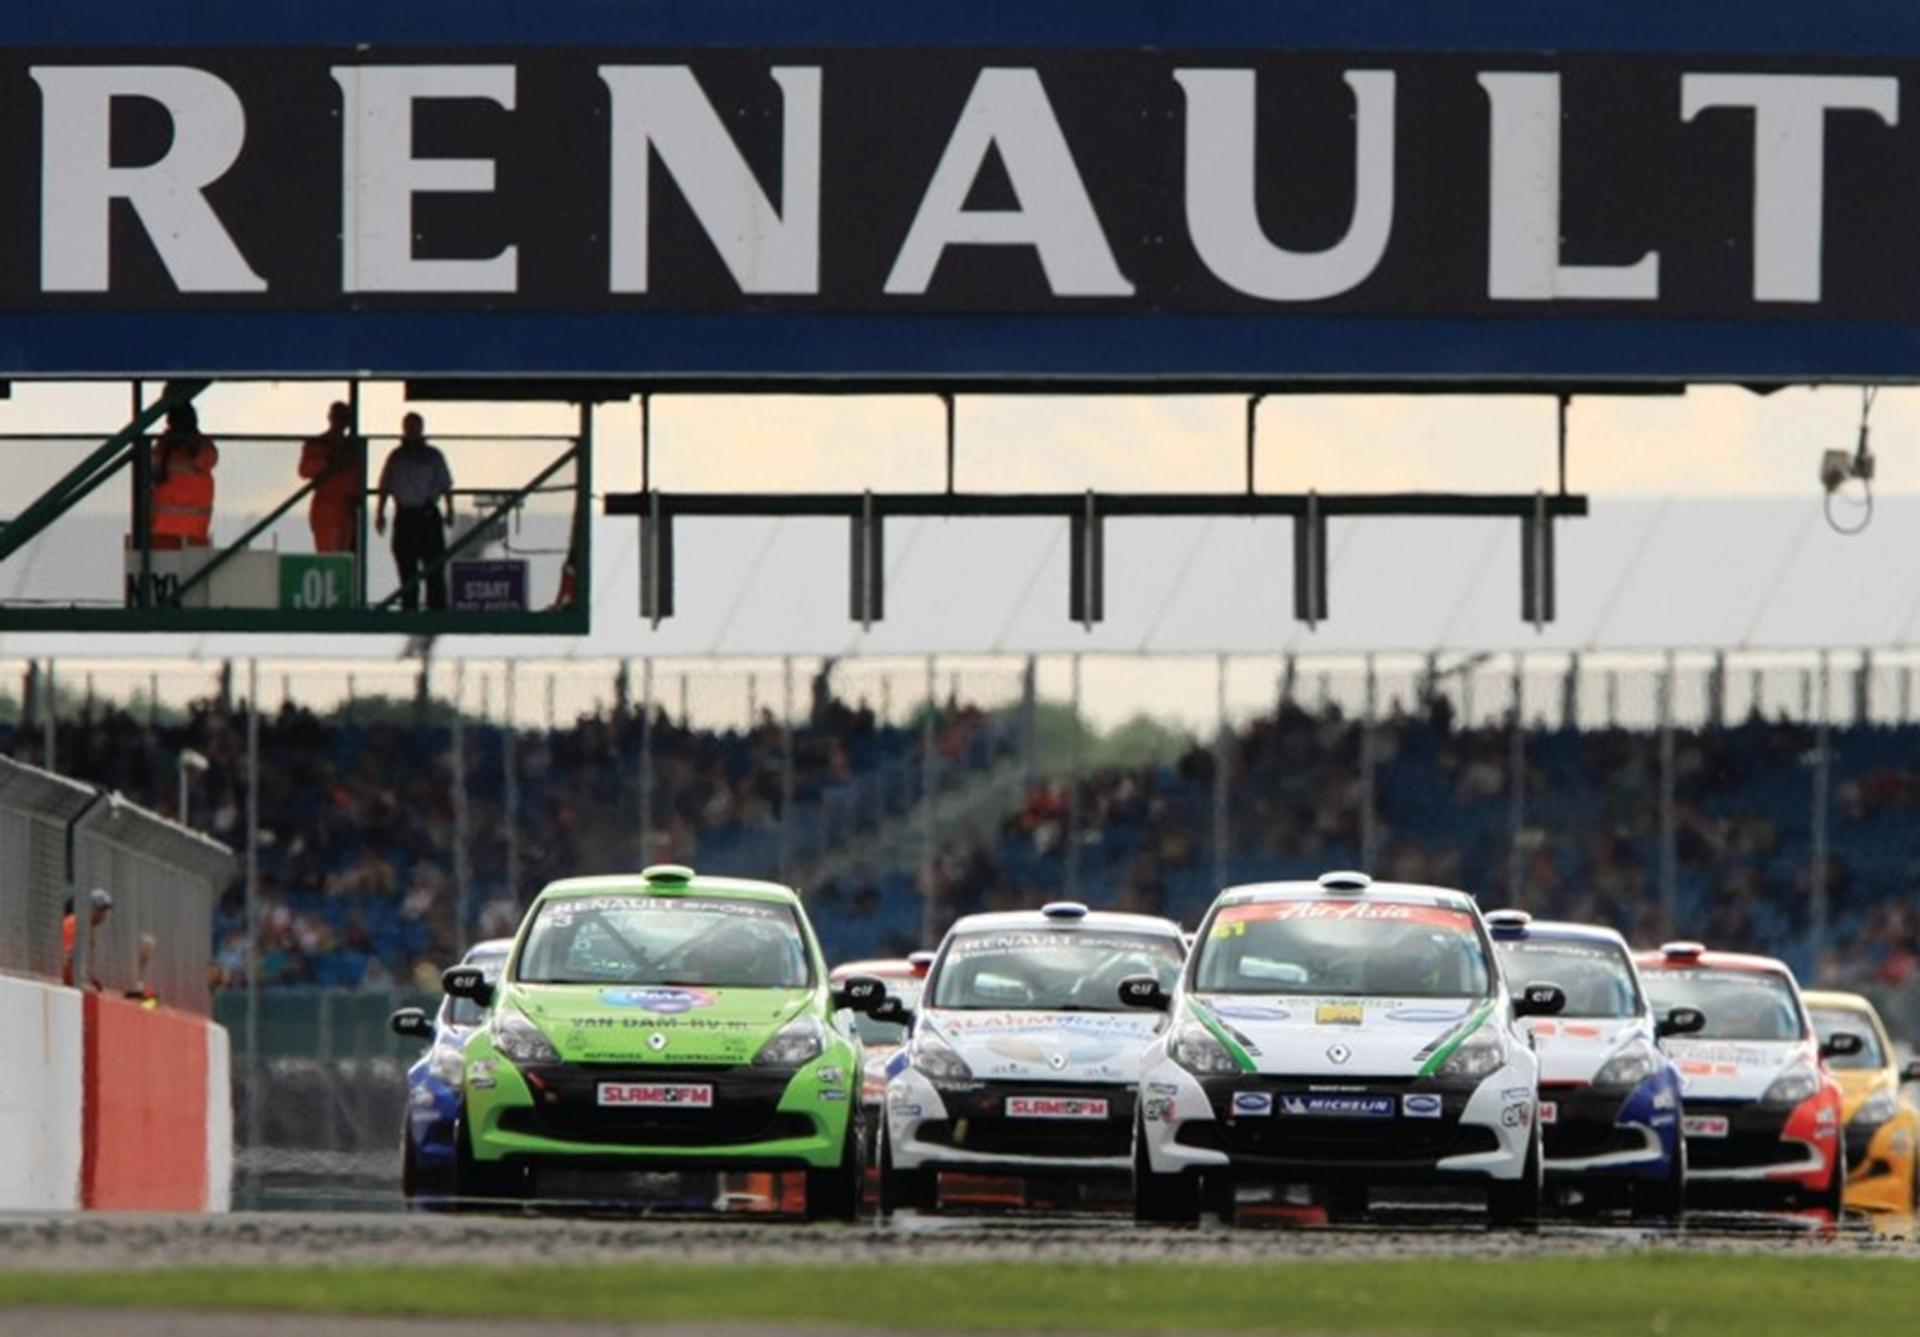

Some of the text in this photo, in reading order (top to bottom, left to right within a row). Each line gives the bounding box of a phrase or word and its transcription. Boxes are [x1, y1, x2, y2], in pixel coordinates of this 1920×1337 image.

[29, 64, 1899, 302] RENAULT
[464, 580, 510, 599] START
[553, 897, 674, 915] RENAULT
[964, 934, 1075, 950] RENAULT
[453, 975, 477, 987] elf
[851, 984, 875, 996] elf
[1130, 983, 1153, 995] elf
[1531, 990, 1555, 1002] elf
[571, 1017, 614, 1029] VAN
[1309, 1099, 1389, 1112] MICHELIN
